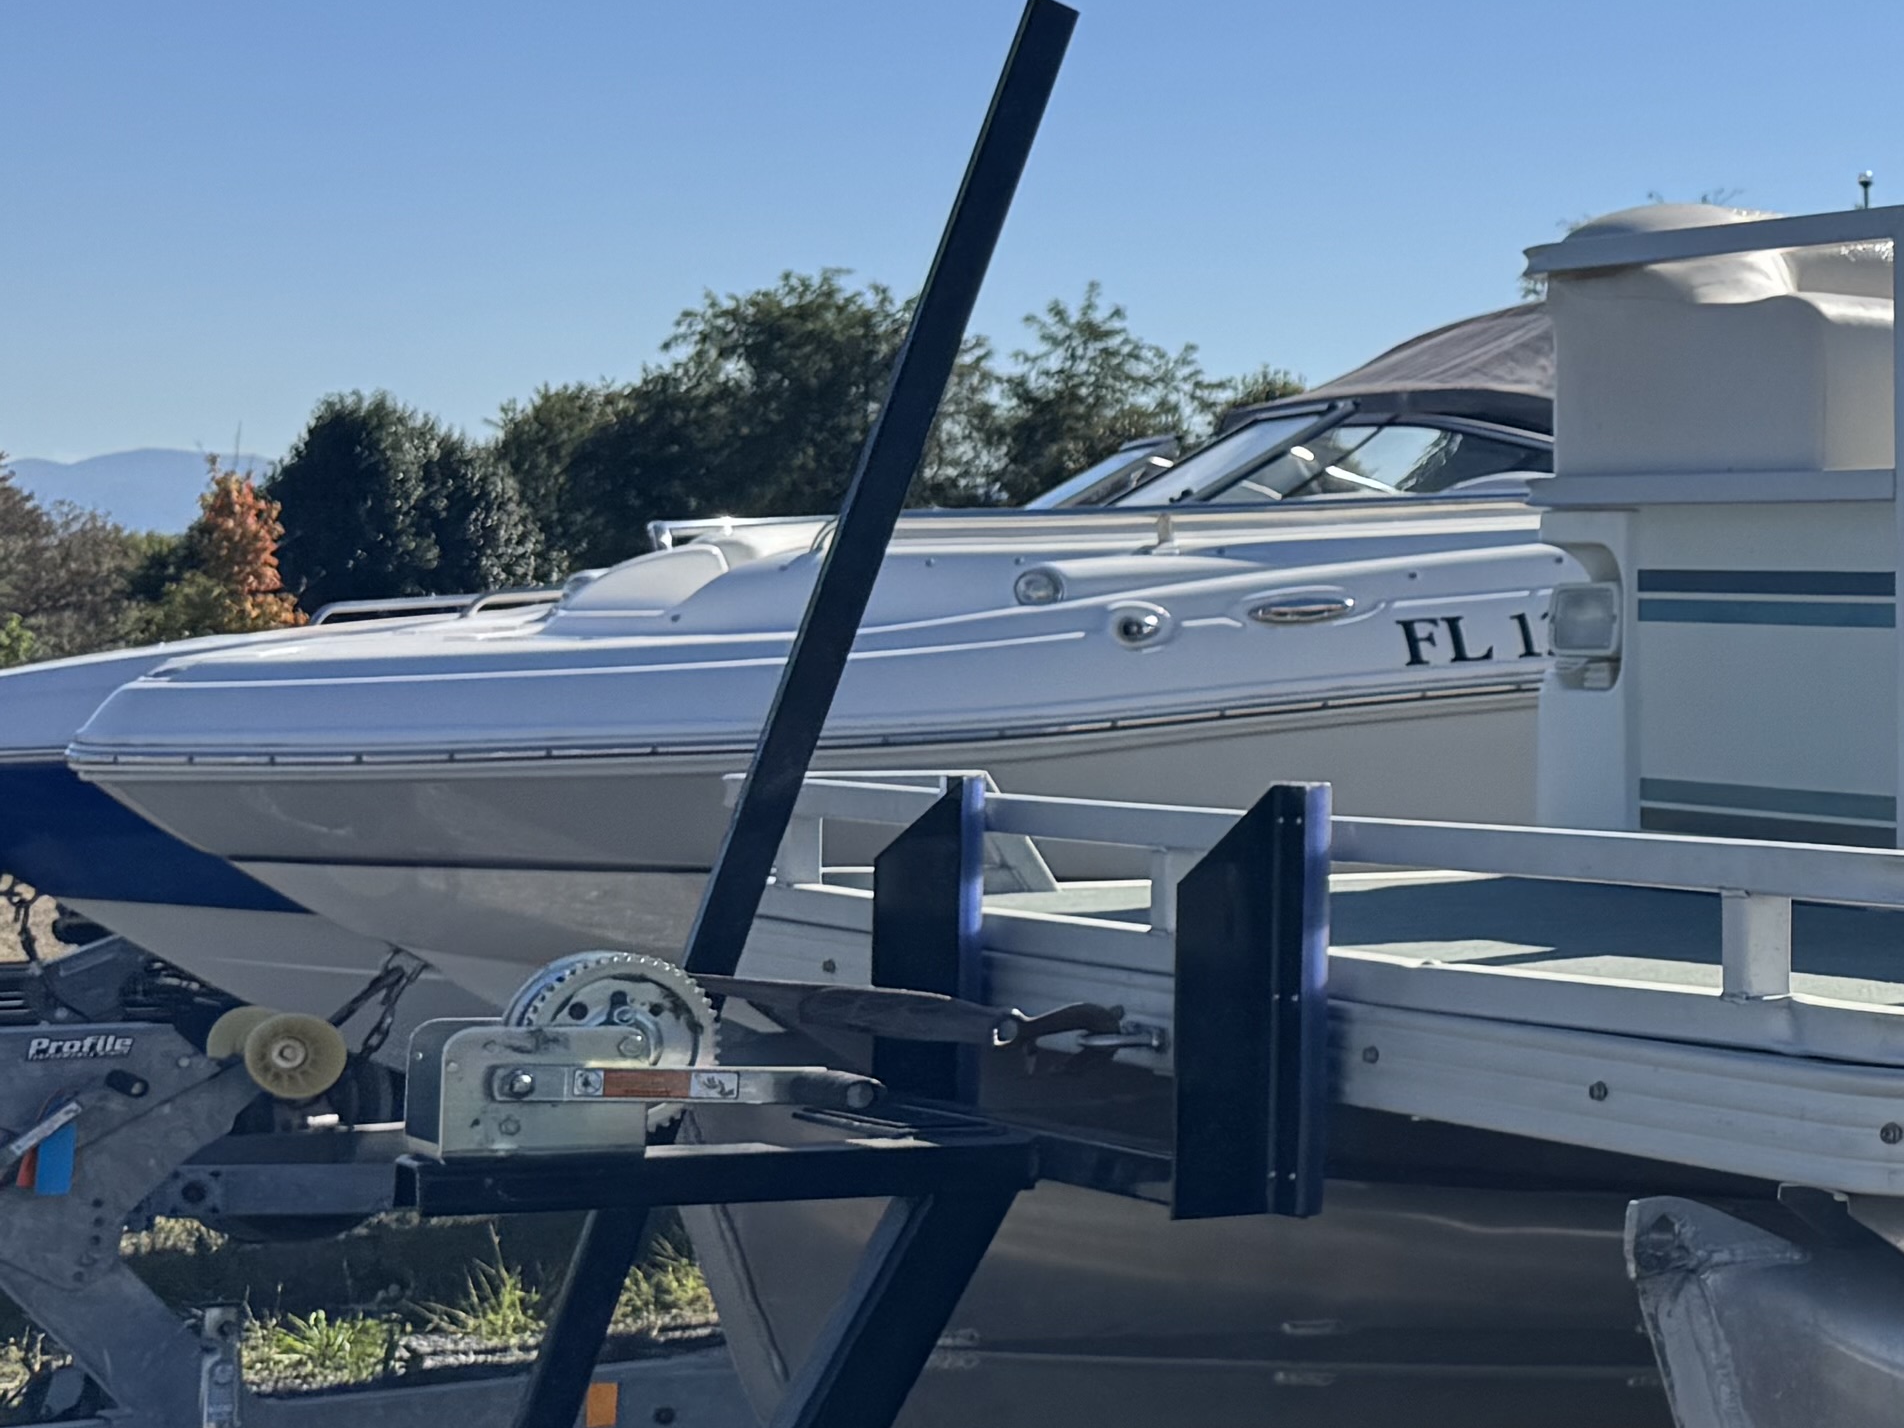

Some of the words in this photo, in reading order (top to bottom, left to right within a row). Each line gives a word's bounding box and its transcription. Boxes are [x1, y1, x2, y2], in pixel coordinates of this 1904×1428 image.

[1395, 615, 1493, 666] FL
[1510, 612, 1554, 659] 1
[28, 1035, 133, 1060] Profile
